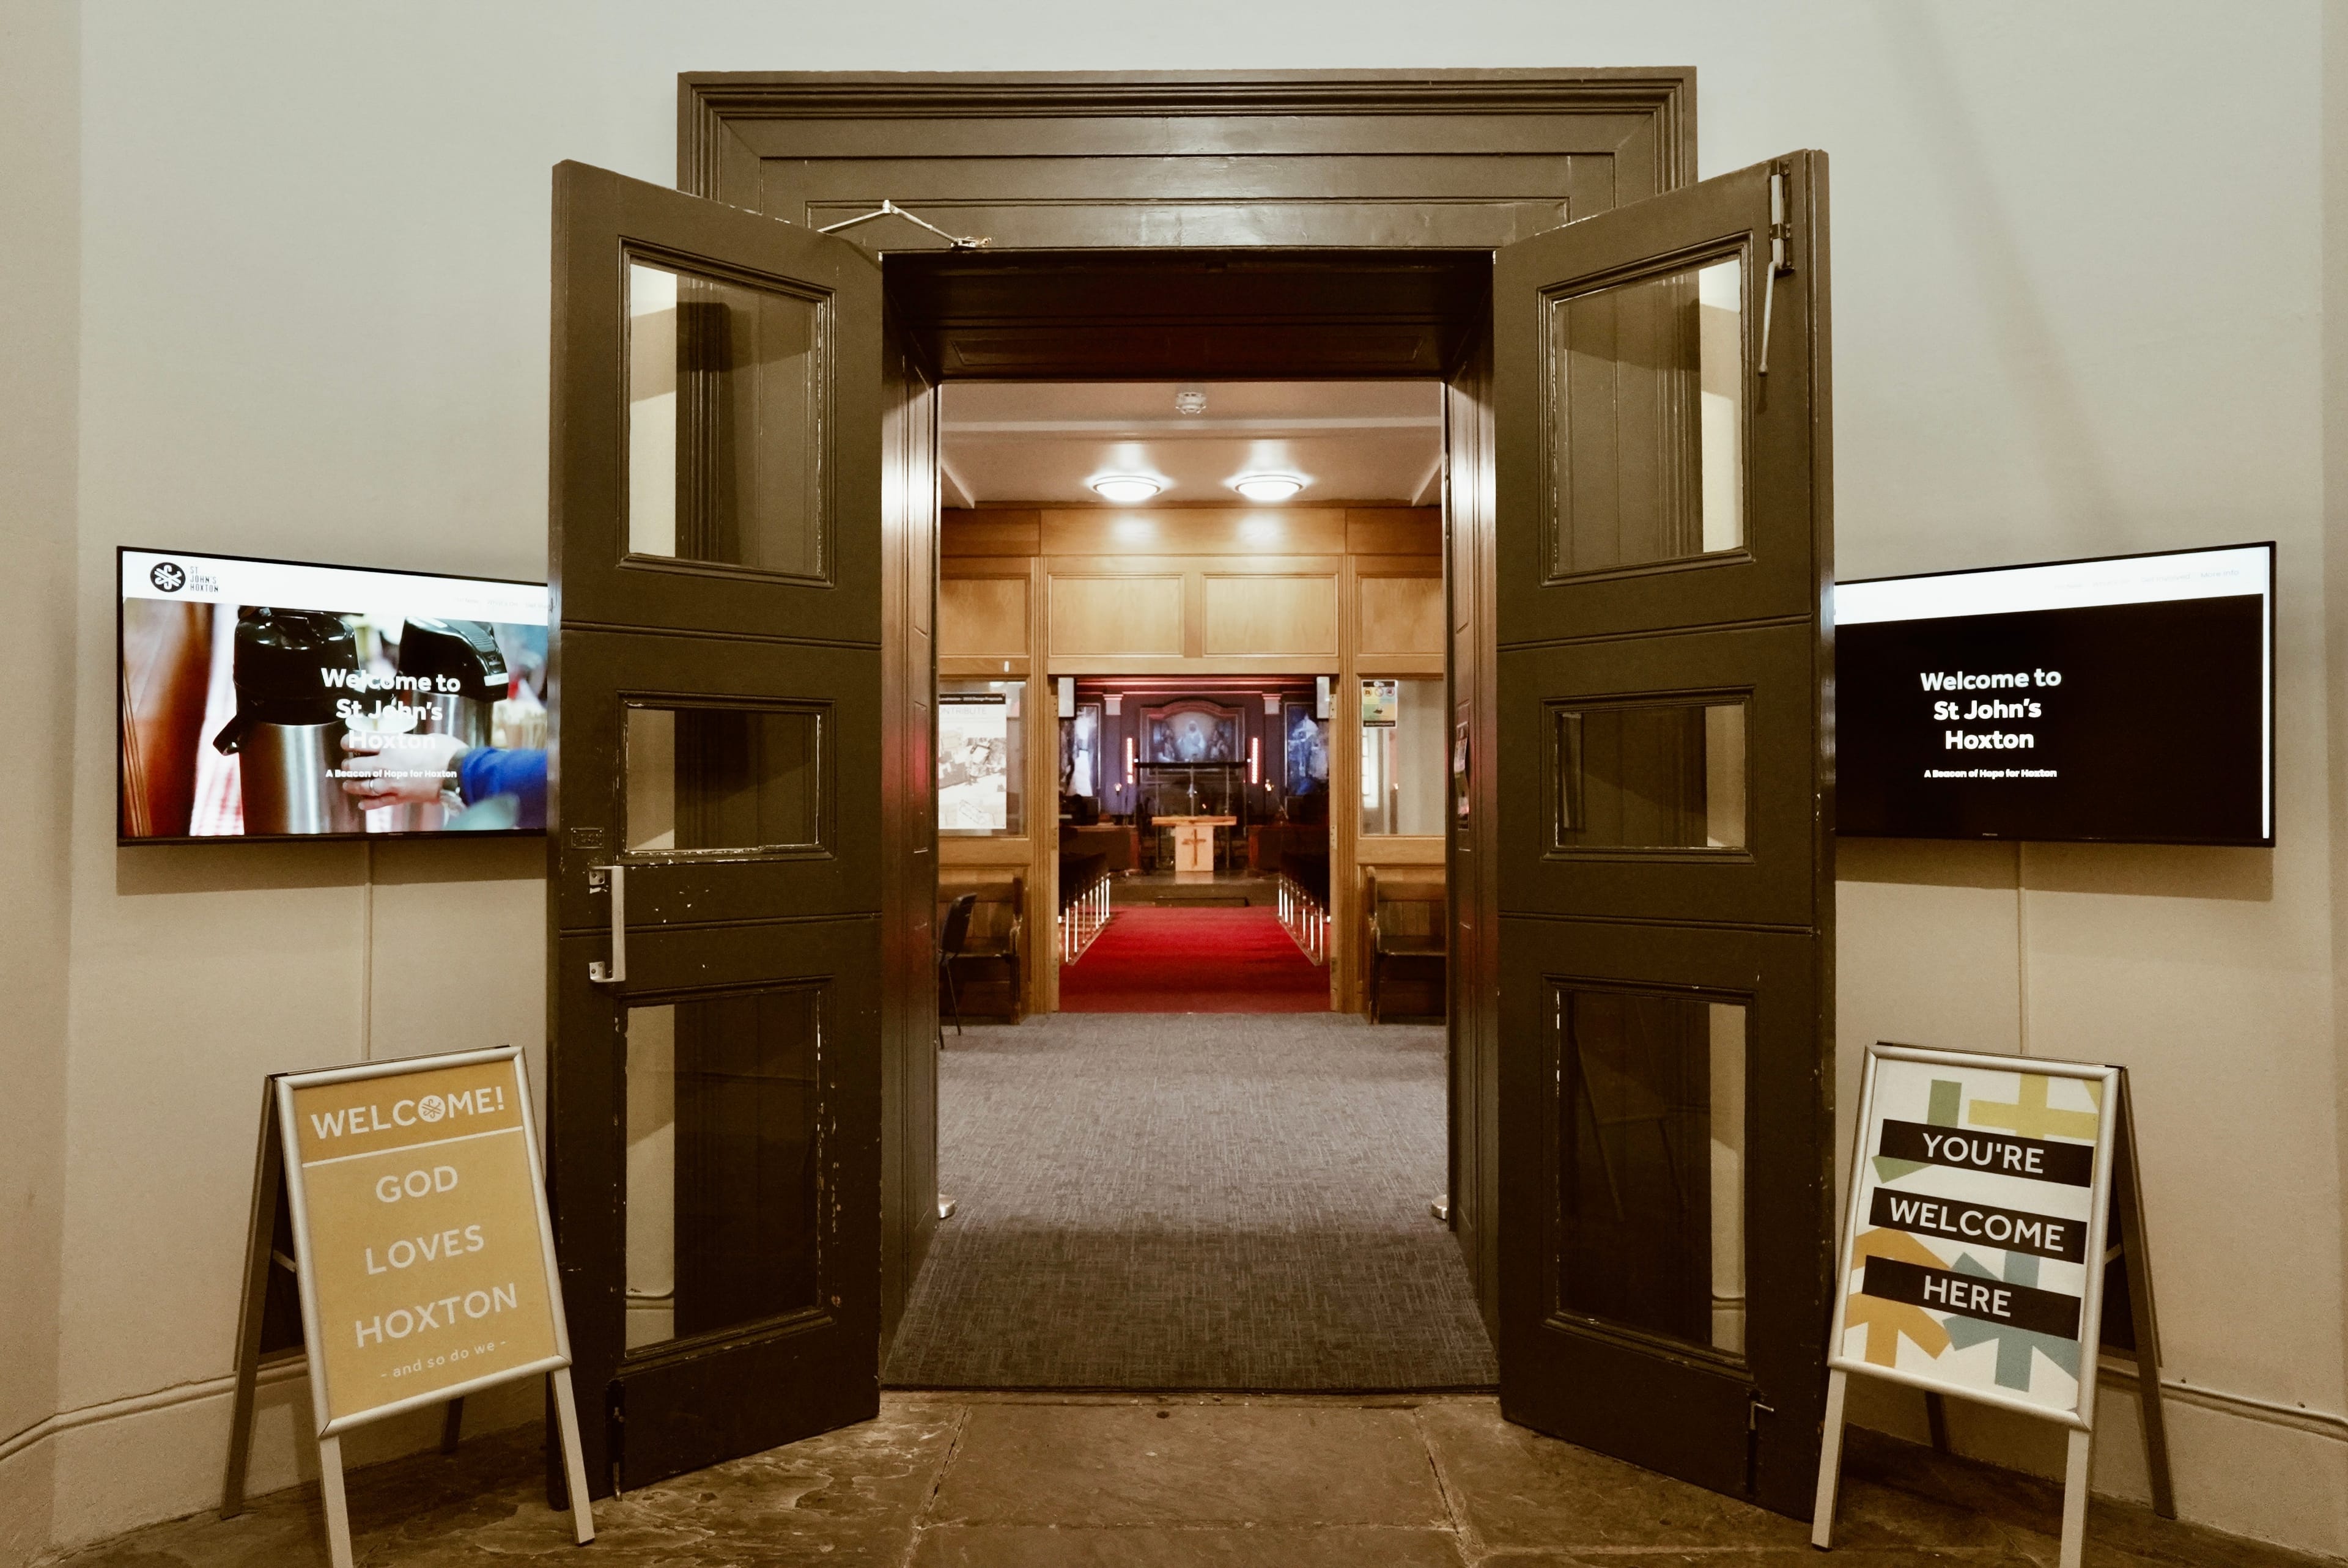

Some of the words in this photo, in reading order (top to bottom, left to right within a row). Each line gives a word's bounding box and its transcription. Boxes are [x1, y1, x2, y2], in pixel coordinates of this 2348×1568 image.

[190, 575, 216, 584] JOHN'S
[190, 583, 218, 592] HOXTON
[321, 668, 432, 690] Welcome
[436, 674, 461, 692] to
[1920, 671, 2029, 691] Welcome
[2034, 668, 2062, 686] to
[336, 698, 363, 719] St
[1933, 701, 1960, 720] St
[1963, 698, 2042, 720] John's
[349, 729, 436, 749] Hoxton
[1945, 730, 2034, 749] Hoxton
[325, 769, 333, 778] A
[372, 768, 382, 778] of
[384, 769, 408, 779] Hope
[410, 769, 423, 778] for
[1932, 769, 1967, 778] Beacon
[1968, 768, 1979, 778] of
[1979, 769, 2004, 779] Hope
[2006, 768, 2020, 778] for
[2021, 769, 2058, 778] Hoxton
[311, 1086, 504, 1139] WELCOME!
[1922, 1133, 2044, 1174] YOU'RE
[375, 1165, 459, 1203] GOD
[1890, 1197, 2064, 1252] WELCOME
[365, 1224, 484, 1275] LOVES
[1924, 1275, 2011, 1317] HERE
[355, 1281, 518, 1348] HOXTON
[393, 1359, 422, 1377] and
[427, 1356, 445, 1368] so
[451, 1349, 470, 1361] do
[474, 1342, 495, 1354] we
